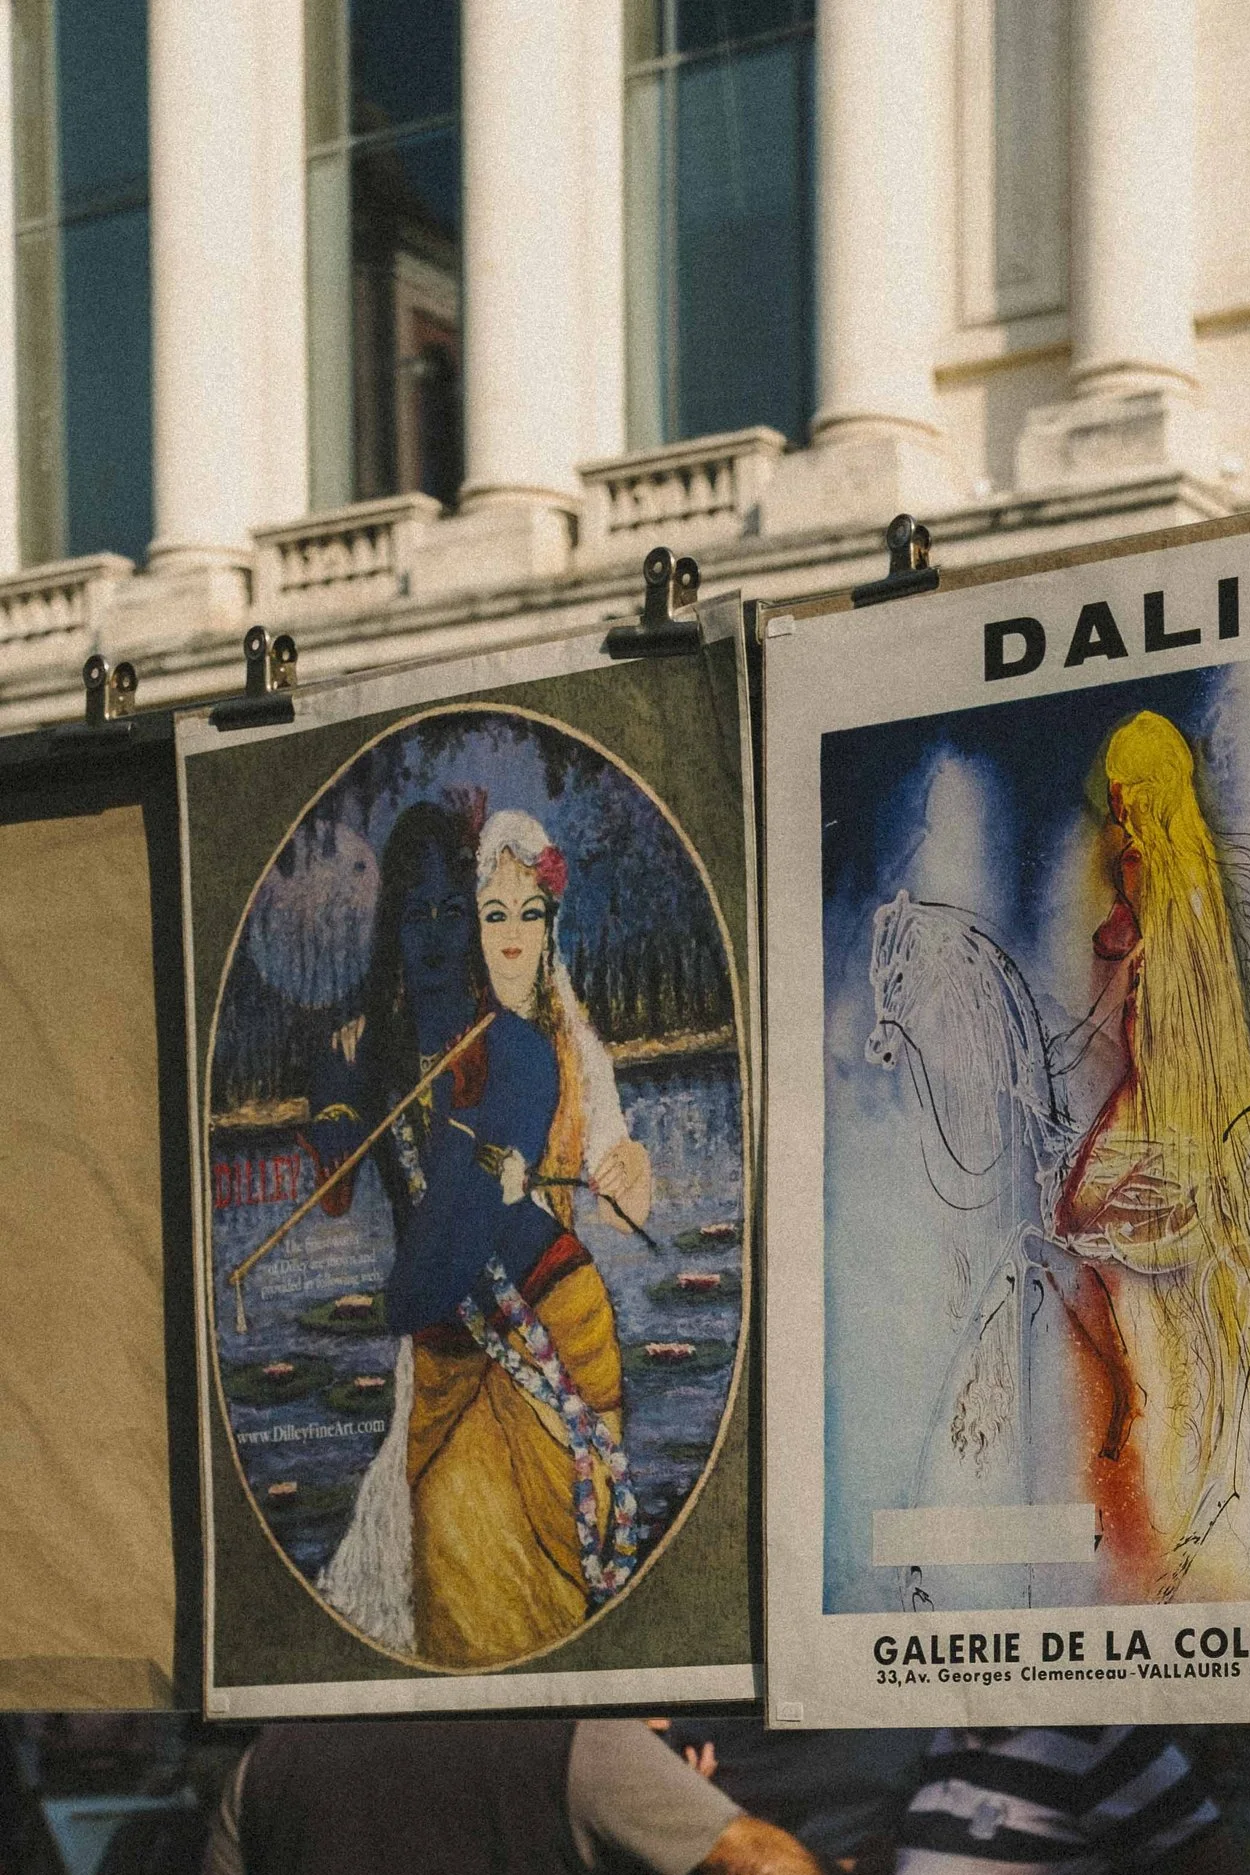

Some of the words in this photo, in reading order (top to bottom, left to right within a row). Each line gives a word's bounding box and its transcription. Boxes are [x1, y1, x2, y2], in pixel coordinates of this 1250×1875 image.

[983, 576, 1241, 682] DALI
[213, 1153, 300, 1210] DILLEY
[236, 1418, 386, 1445] www.DilleyFineArt.com
[873, 1632, 1021, 1666] GALERIE
[1041, 1631, 1085, 1663] DE
[1106, 1629, 1152, 1662] LA
[938, 1668, 1012, 1686] Georges
